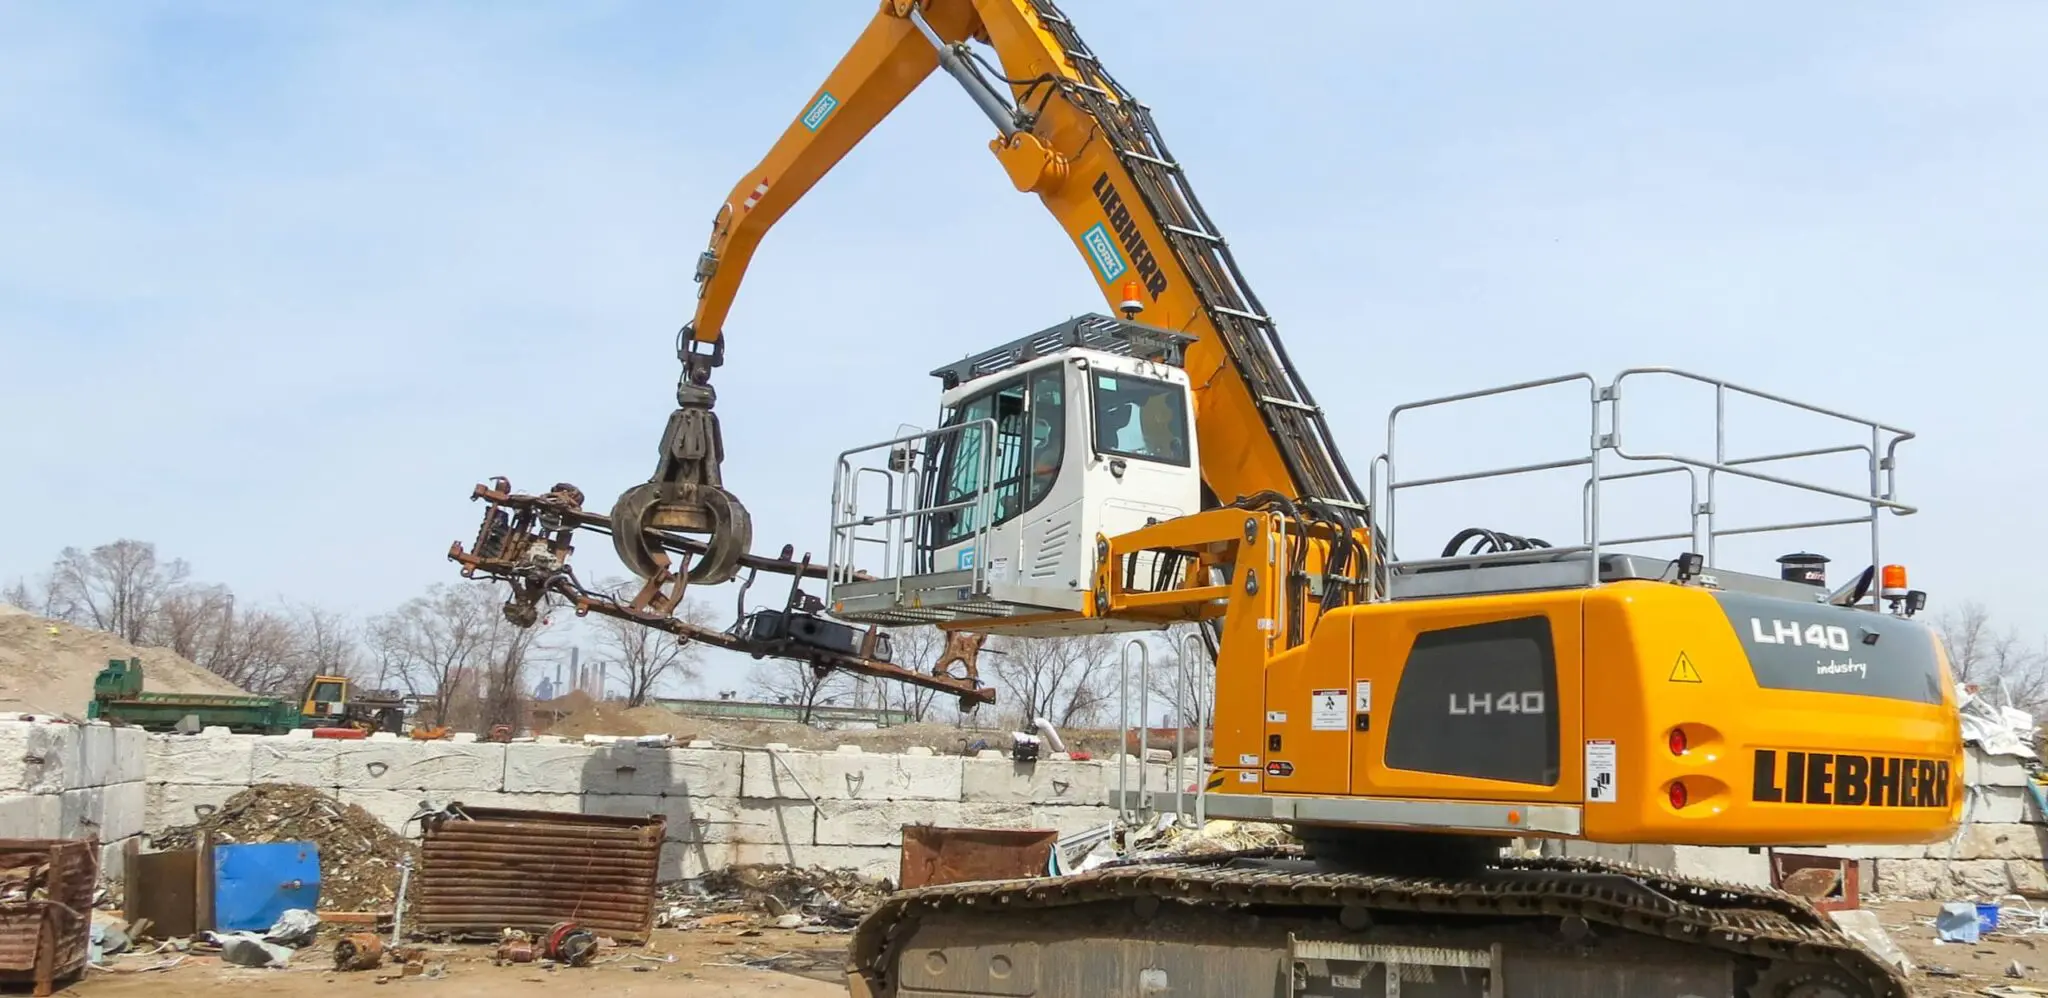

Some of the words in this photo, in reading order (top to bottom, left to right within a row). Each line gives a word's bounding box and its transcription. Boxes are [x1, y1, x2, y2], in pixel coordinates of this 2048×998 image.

[1092, 172, 1168, 303] LIEBHERR
[1817, 658, 1867, 679] industry
[1752, 750, 1949, 807] LIEBHERR
